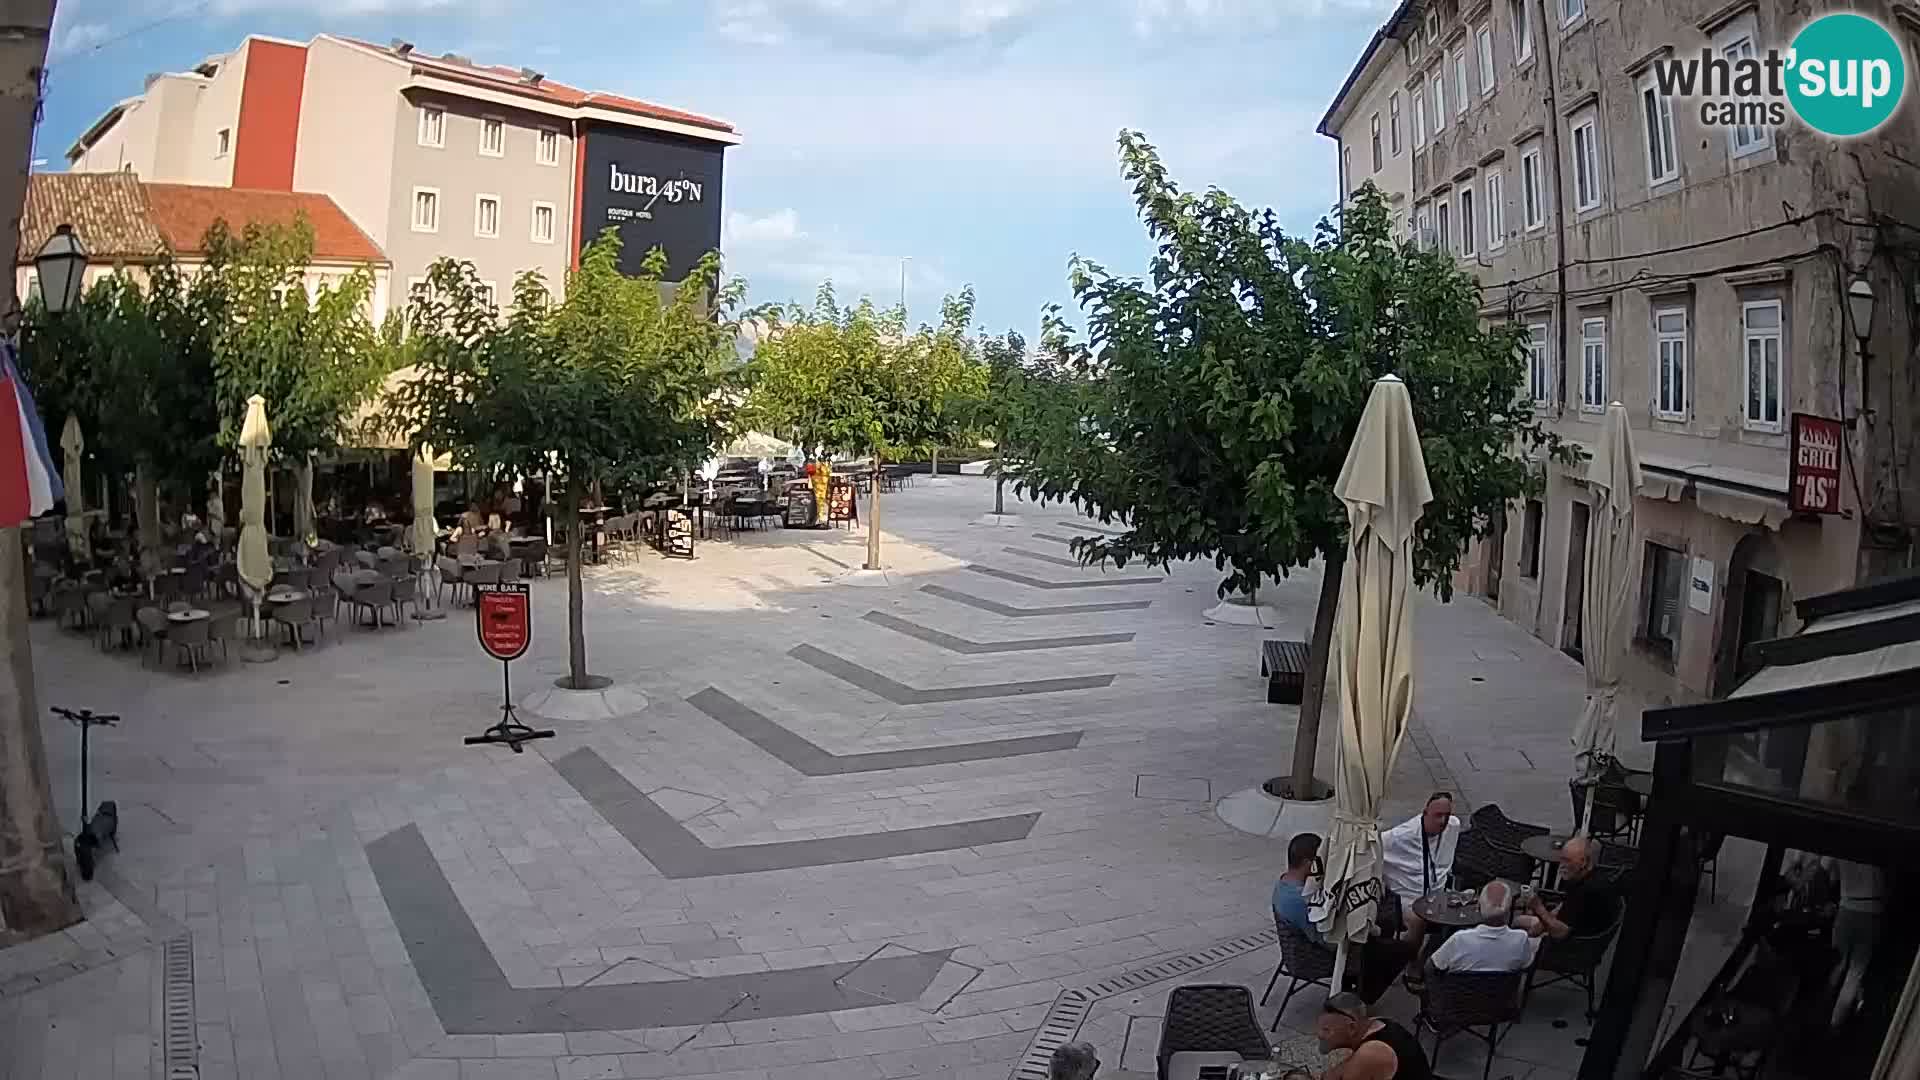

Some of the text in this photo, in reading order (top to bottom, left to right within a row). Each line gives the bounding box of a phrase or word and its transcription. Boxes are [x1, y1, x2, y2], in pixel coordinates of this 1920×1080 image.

[636, 211, 653, 220] HOTEL
[1798, 446, 1838, 470] GRILL
[477, 584, 498, 592] WINE
[500, 584, 518, 592] BAR
